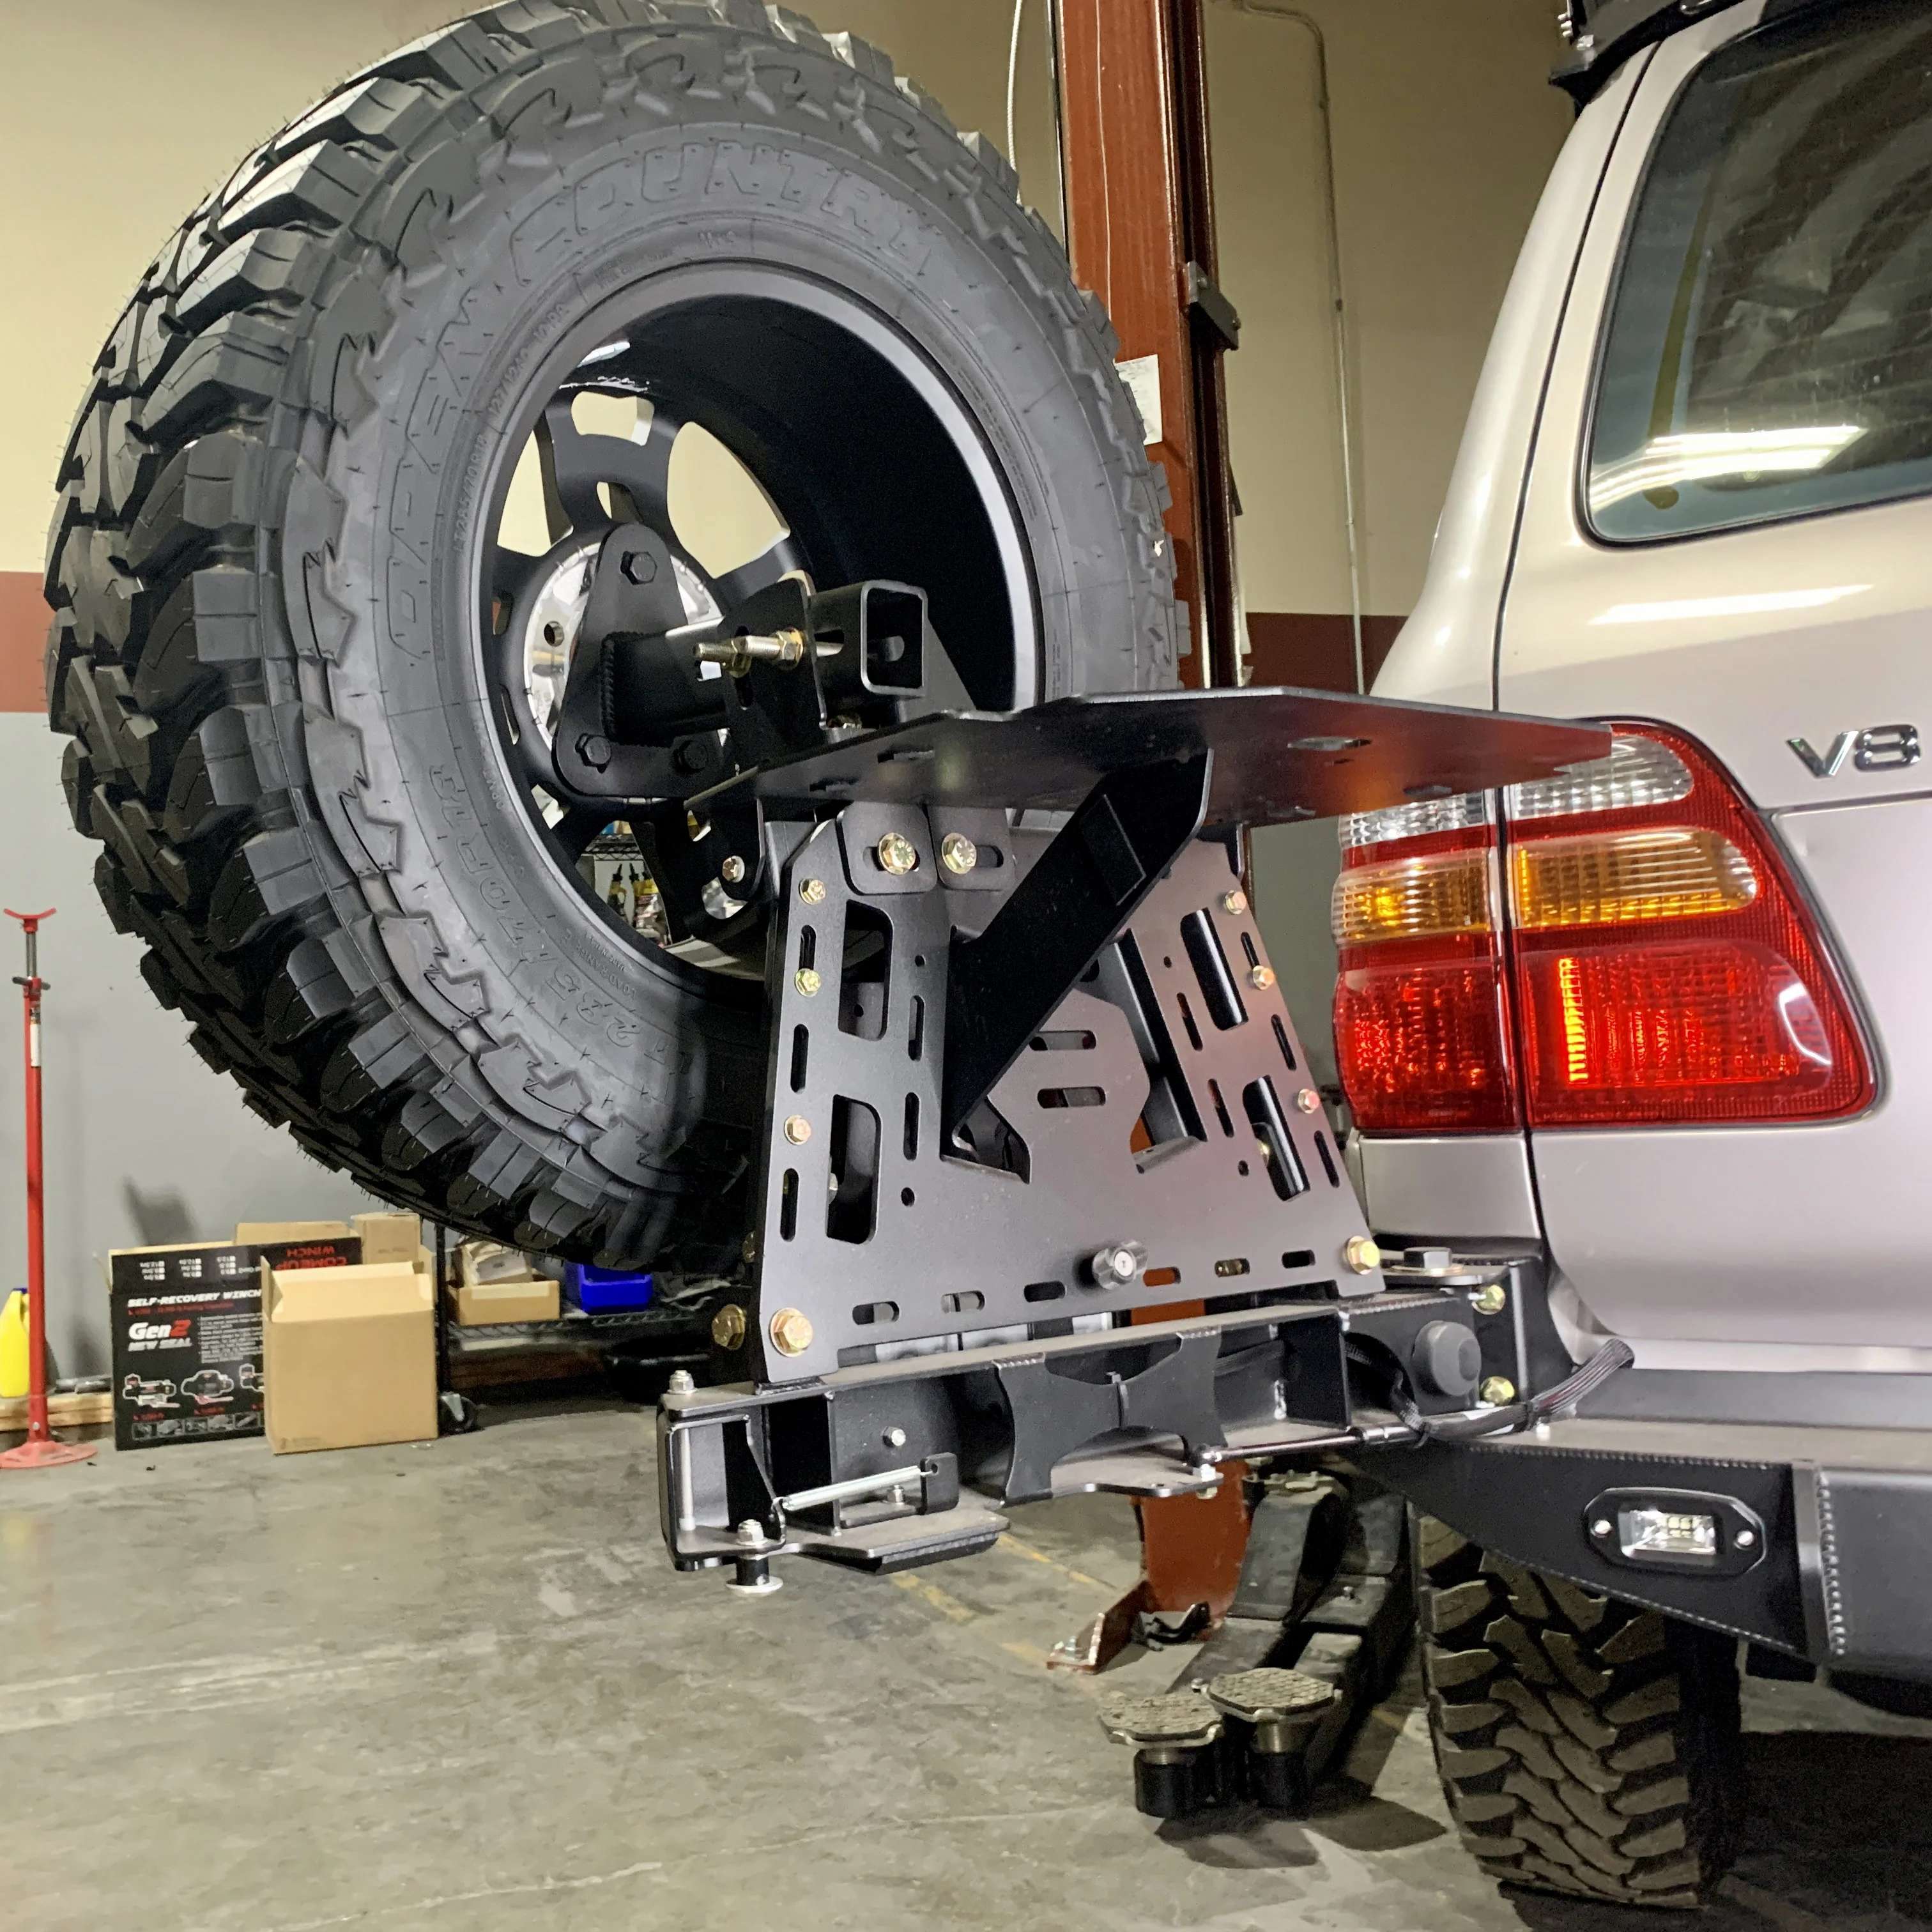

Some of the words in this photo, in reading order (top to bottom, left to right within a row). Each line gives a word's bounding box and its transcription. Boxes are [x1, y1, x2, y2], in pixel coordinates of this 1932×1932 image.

[386, 284, 493, 660] OPEN
[510, 139, 942, 287] COUNTRY
[1785, 724, 1921, 778] V8
[574, 942, 608, 976] RANGE
[608, 974, 636, 997] LOAD
[286, 1245, 335, 1258] WINCH
[127, 1291, 220, 1308] SELF-RECOVERY
[222, 1289, 262, 1300] WINCH
[128, 1319, 192, 1340] Gen2
